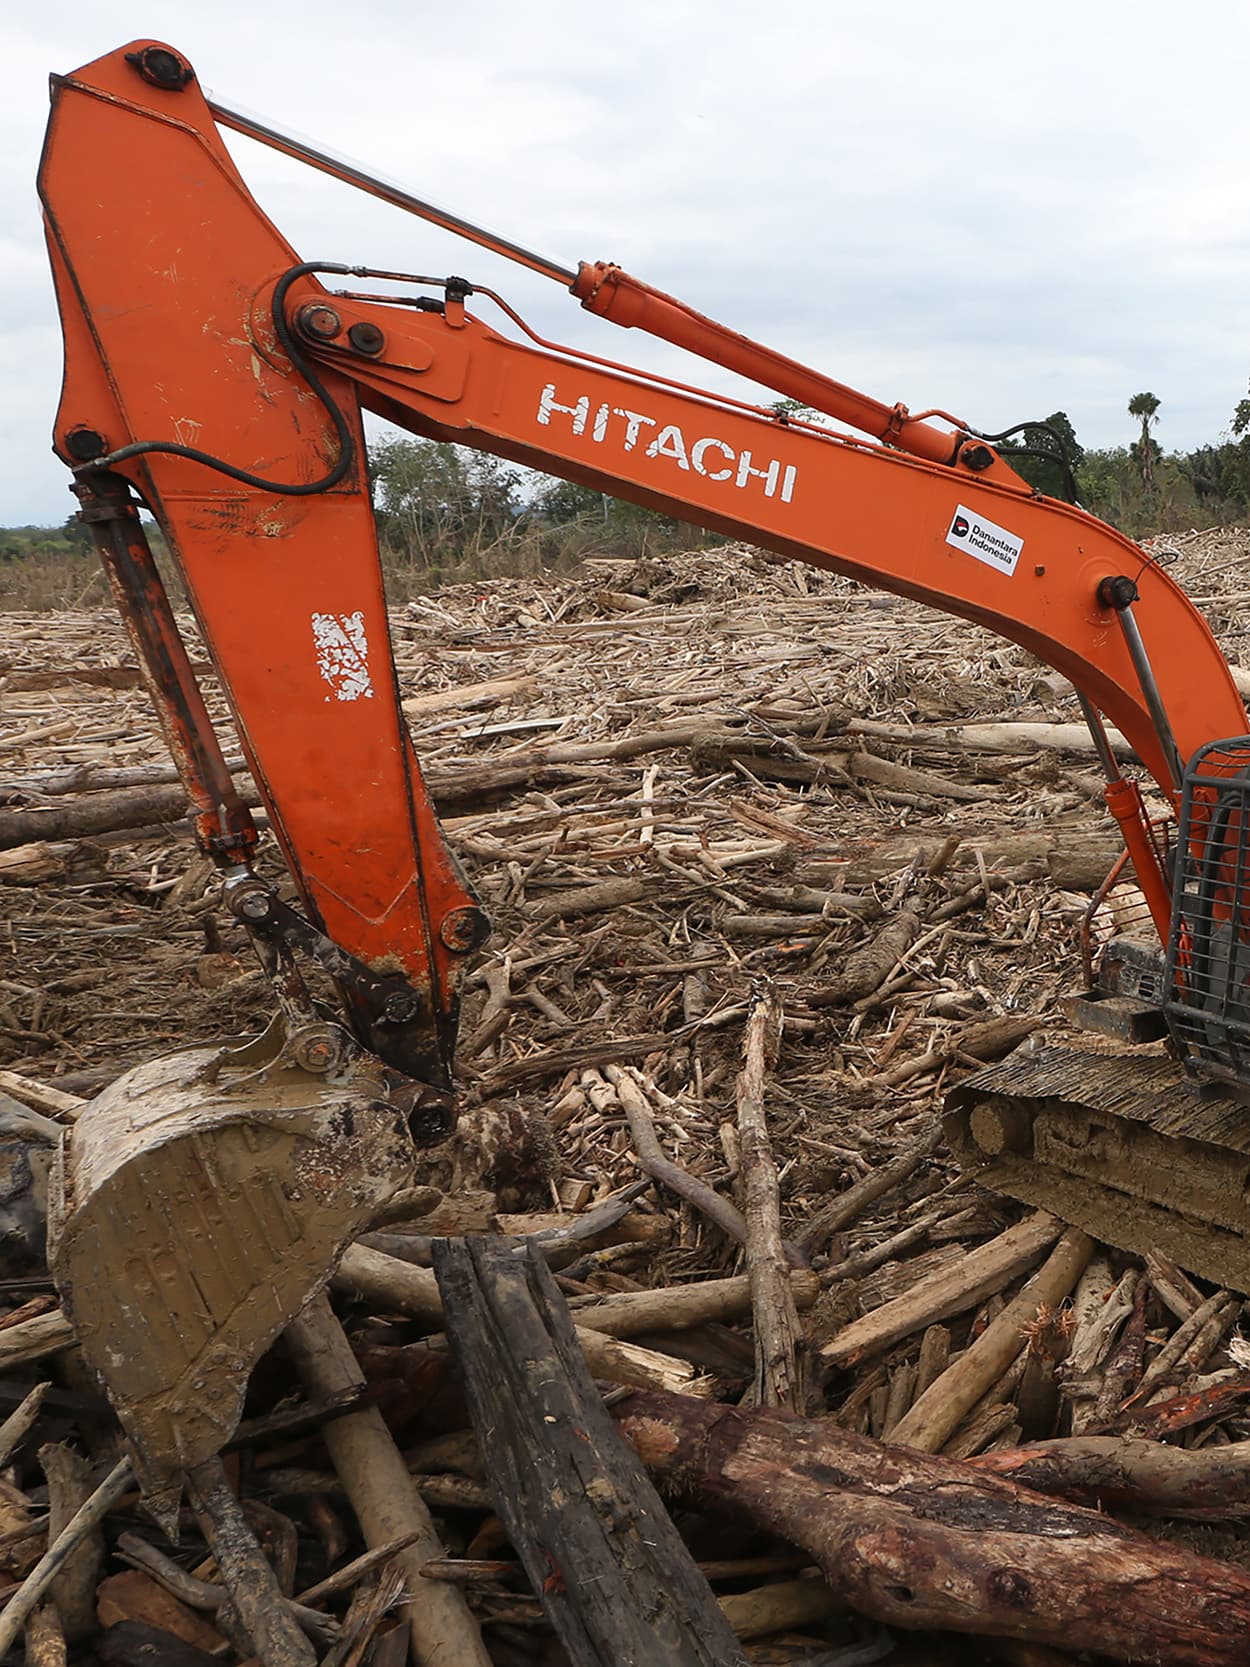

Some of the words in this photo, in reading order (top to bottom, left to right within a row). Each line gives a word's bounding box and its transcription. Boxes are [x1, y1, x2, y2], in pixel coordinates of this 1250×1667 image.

[537, 384, 797, 503] HITACHI
[968, 534, 1012, 565] Indonesia
[972, 524, 1018, 557] Danantara
